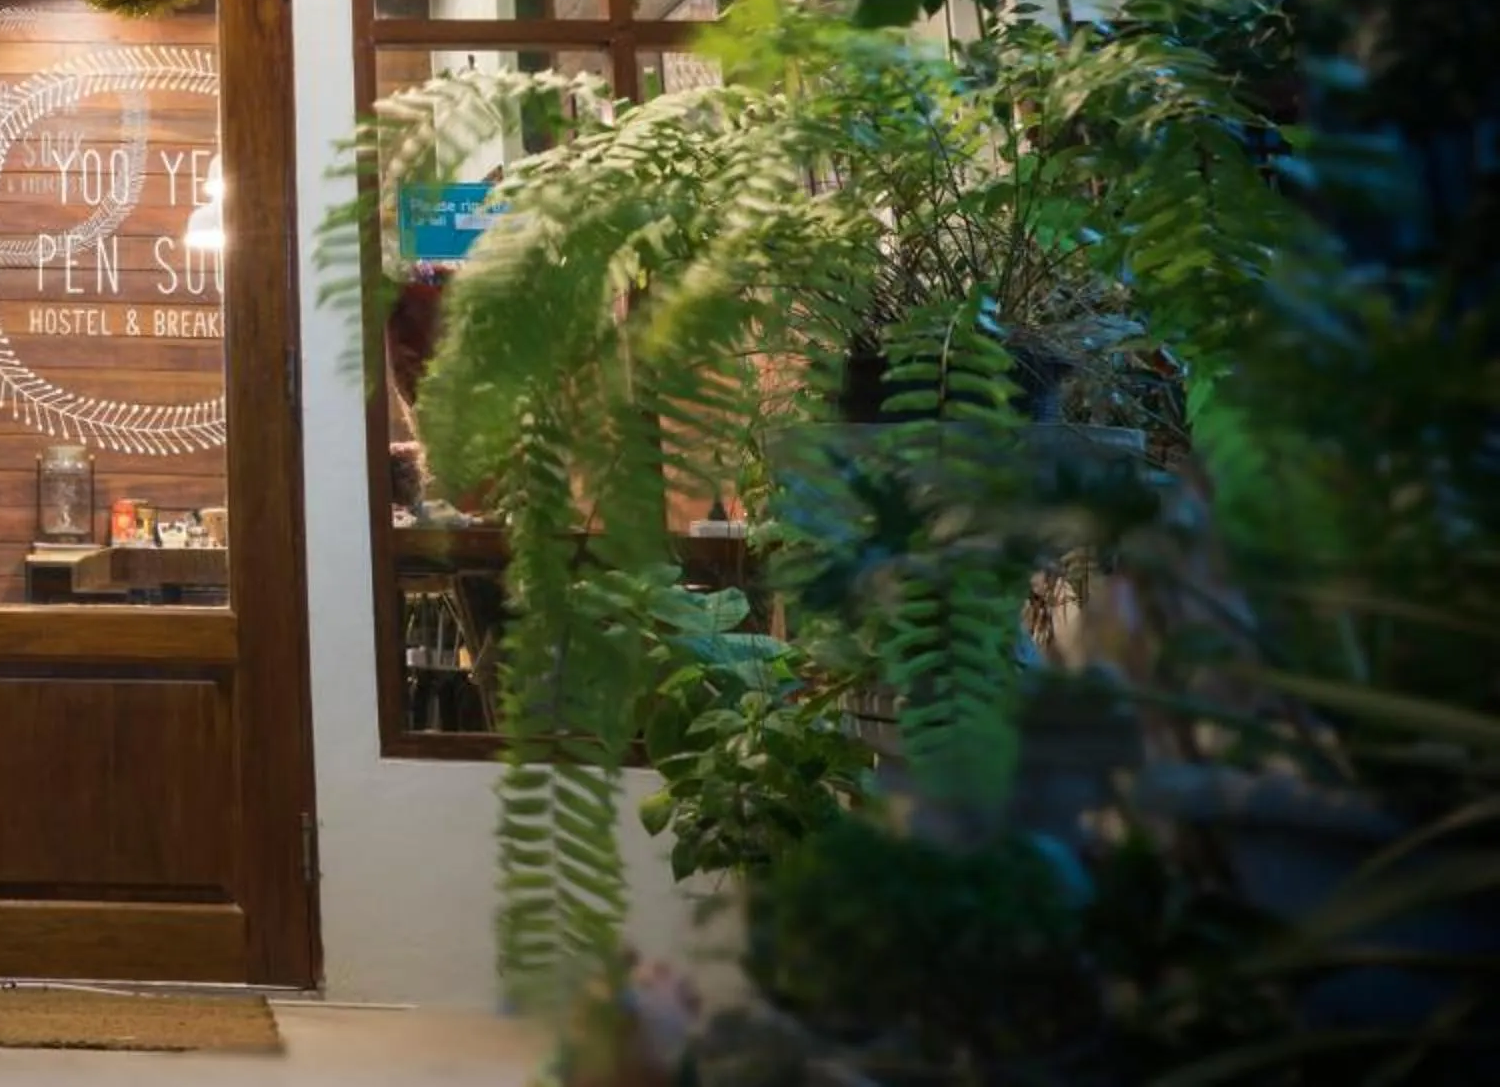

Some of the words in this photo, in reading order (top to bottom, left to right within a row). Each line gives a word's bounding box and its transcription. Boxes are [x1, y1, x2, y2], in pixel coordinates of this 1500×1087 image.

[52, 149, 130, 205] YOO
[160, 150, 213, 206] YE
[38, 234, 120, 294] PEN
[155, 236, 224, 294] SO
[29, 309, 113, 335] HOSTEL
[125, 309, 140, 336] &
[153, 310, 223, 338] BREAK
